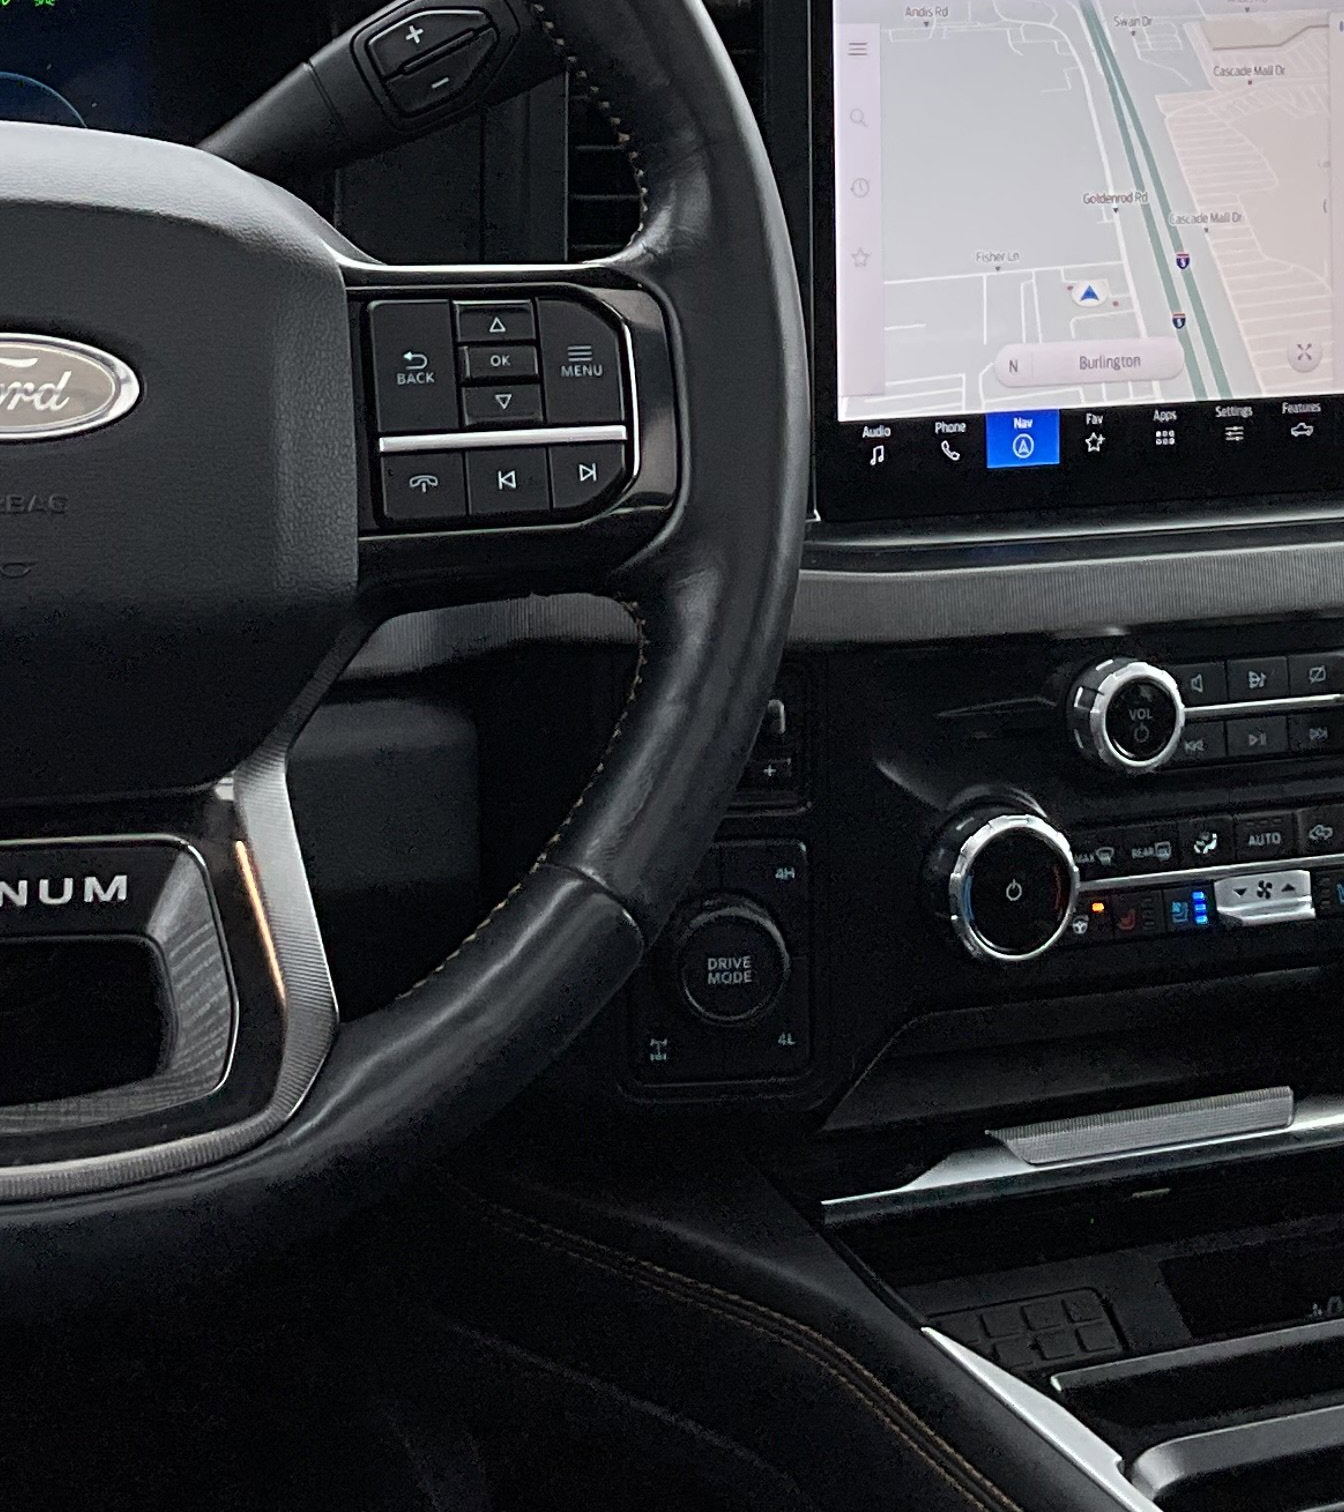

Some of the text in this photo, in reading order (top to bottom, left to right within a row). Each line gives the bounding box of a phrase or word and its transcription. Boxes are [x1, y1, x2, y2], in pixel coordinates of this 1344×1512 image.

[905, 5, 949, 17] Andis Rd
[1113, 16, 1139, 27] Swan
[1213, 65, 1286, 77] Cascade Mall Dr
[1083, 192, 1148, 205] Goldenrod Rd
[1210, 212, 1230, 224] Mall
[1232, 212, 1242, 223] Dr
[976, 251, 1005, 263] Fisher
[490, 355, 511, 367] OK
[1009, 355, 1141, 373] N Burlington
[561, 365, 603, 377] MENU
[397, 372, 435, 385] BACK
[1215, 405, 1253, 418] Settings
[1281, 402, 1321, 414] Features
[1086, 413, 1104, 425] Fav
[1153, 409, 1177, 422] Apps
[935, 421, 967, 434] Phone
[1013, 417, 1033, 430] Nav
[862, 426, 891, 438] Audio
[1129, 708, 1153, 721] VOL
[1248, 832, 1281, 846] AUTO
[775, 867, 796, 880] 4H
[707, 956, 752, 971] DRIVE
[707, 970, 753, 985] MODE
[777, 1033, 796, 1046] 4L
